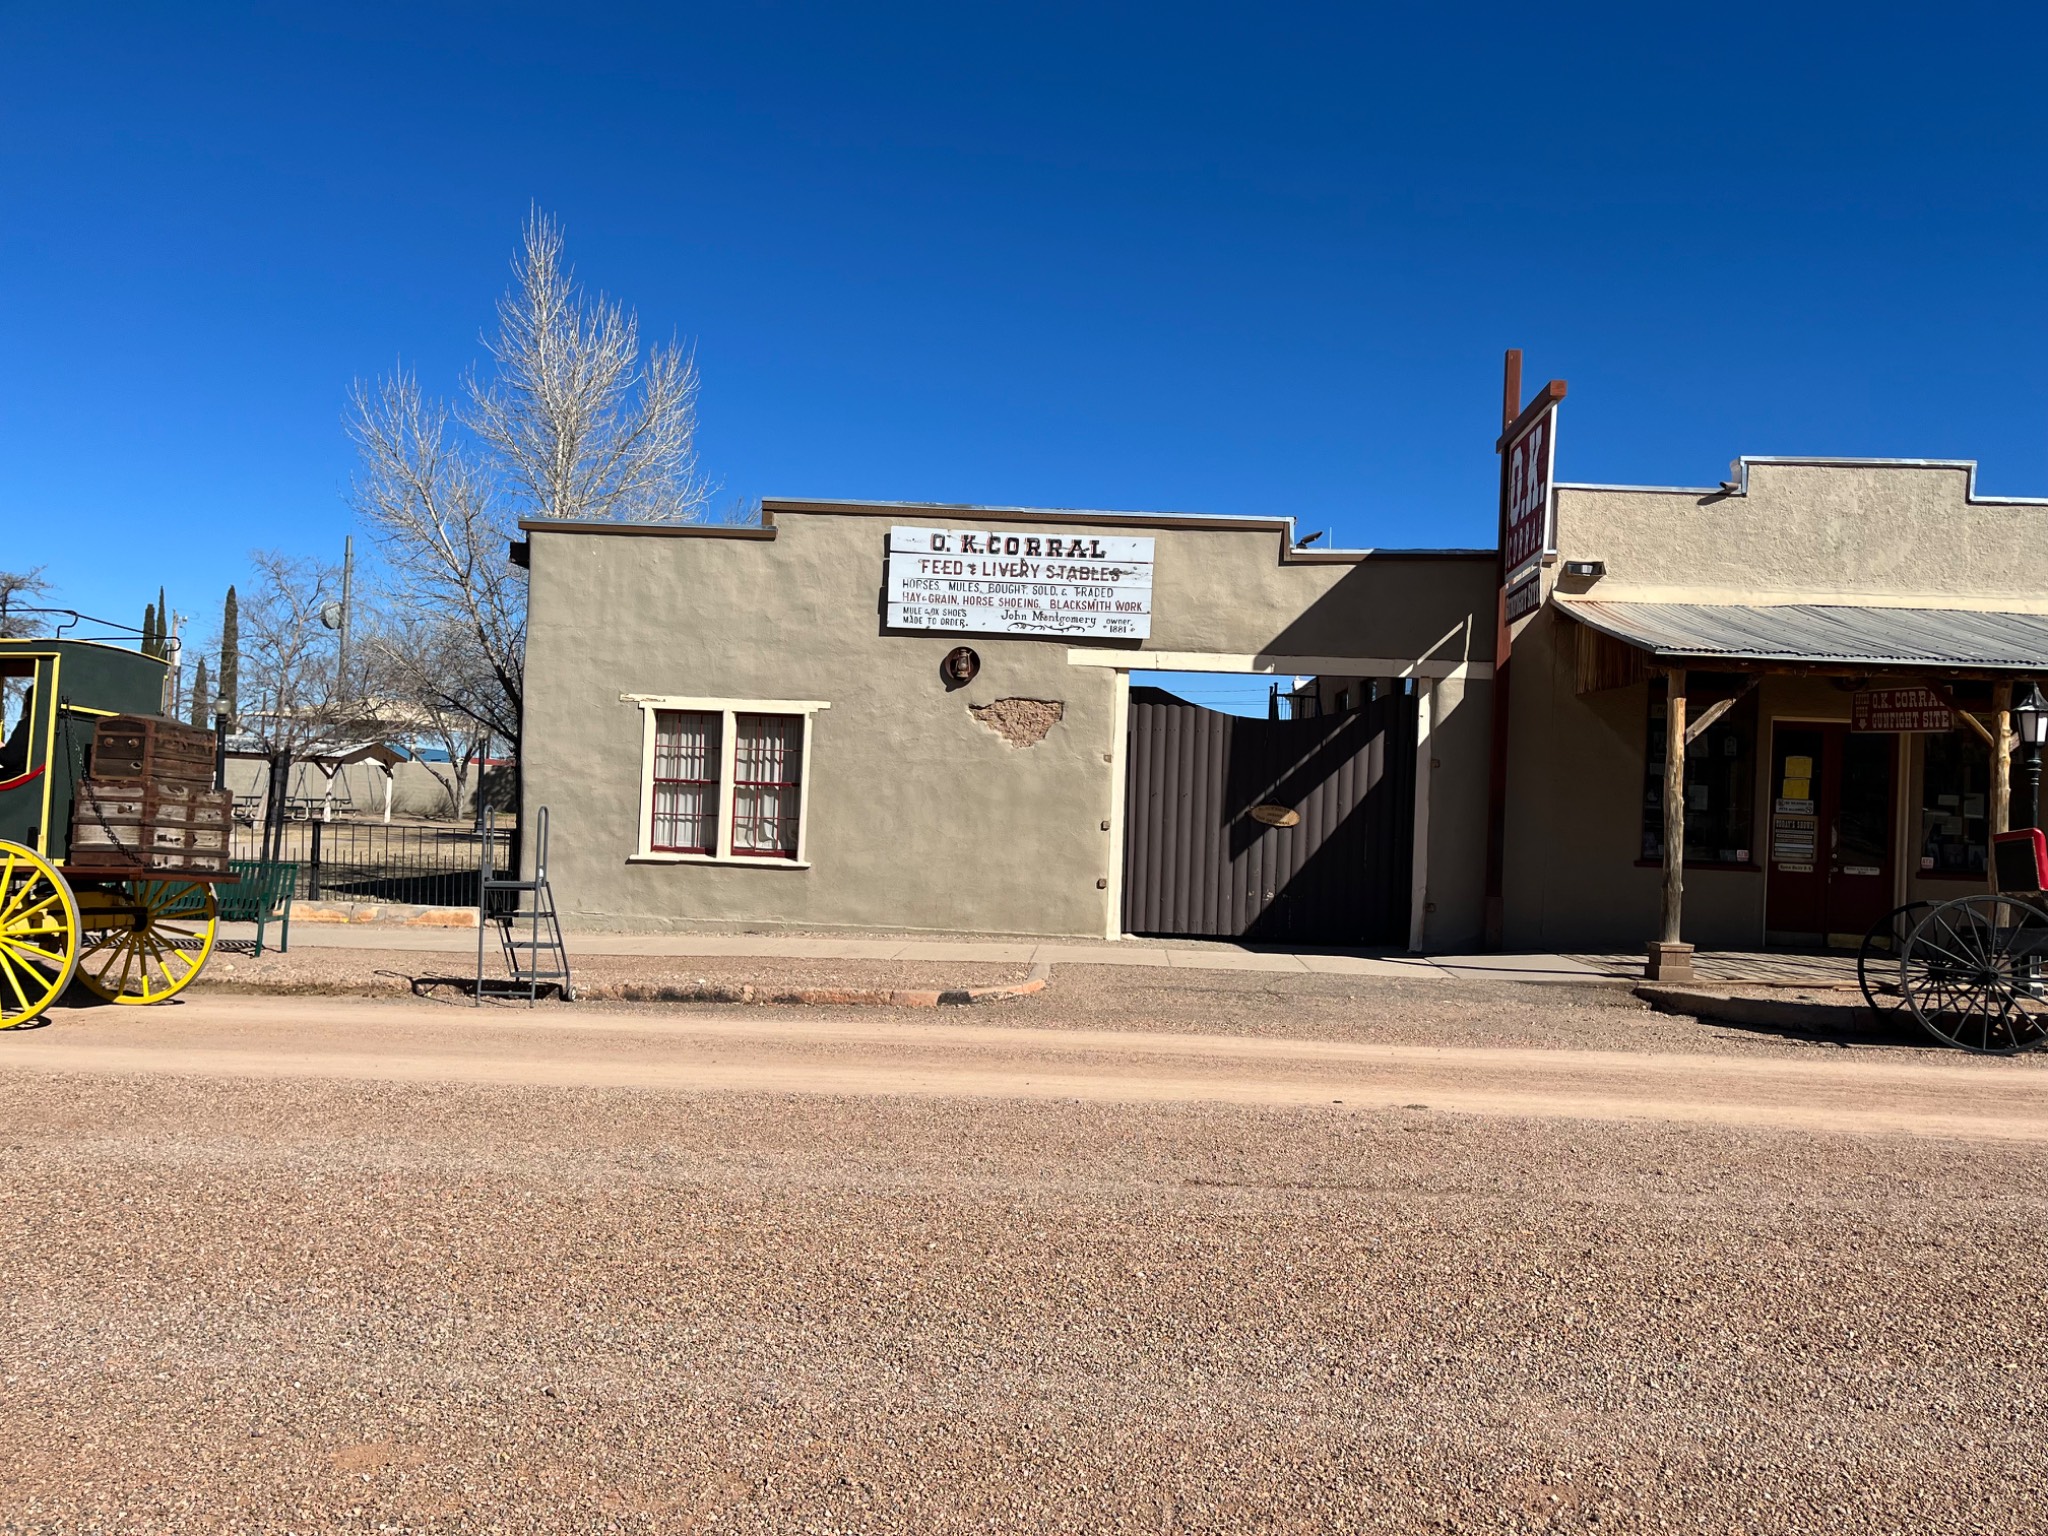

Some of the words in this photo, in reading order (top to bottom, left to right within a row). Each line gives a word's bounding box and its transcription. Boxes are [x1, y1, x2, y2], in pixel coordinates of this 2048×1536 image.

[986, 535, 1106, 558] CORRAL
[1505, 511, 1543, 570] CORRAL
[921, 559, 963, 576] FEED
[982, 561, 1040, 579] LIVERY
[1046, 565, 1120, 582] STABLES
[1073, 586, 1114, 598] TRADED
[903, 606, 921, 616] MULE
[942, 608, 967, 618] SHOES
[962, 595, 994, 607] HORSE
[1050, 599, 1112, 611] BLACKSMITH
[1115, 600, 1143, 612] WORK
[903, 616, 922, 625] MADE
[927, 617, 937, 625] TO
[1001, 609, 1027, 621] John
[1032, 610, 1097, 628] Montgomery
[1109, 624, 1127, 633] 1881
[1871, 711, 1919, 729] GUNFIGHT
[1922, 710, 1950, 728] SITE
